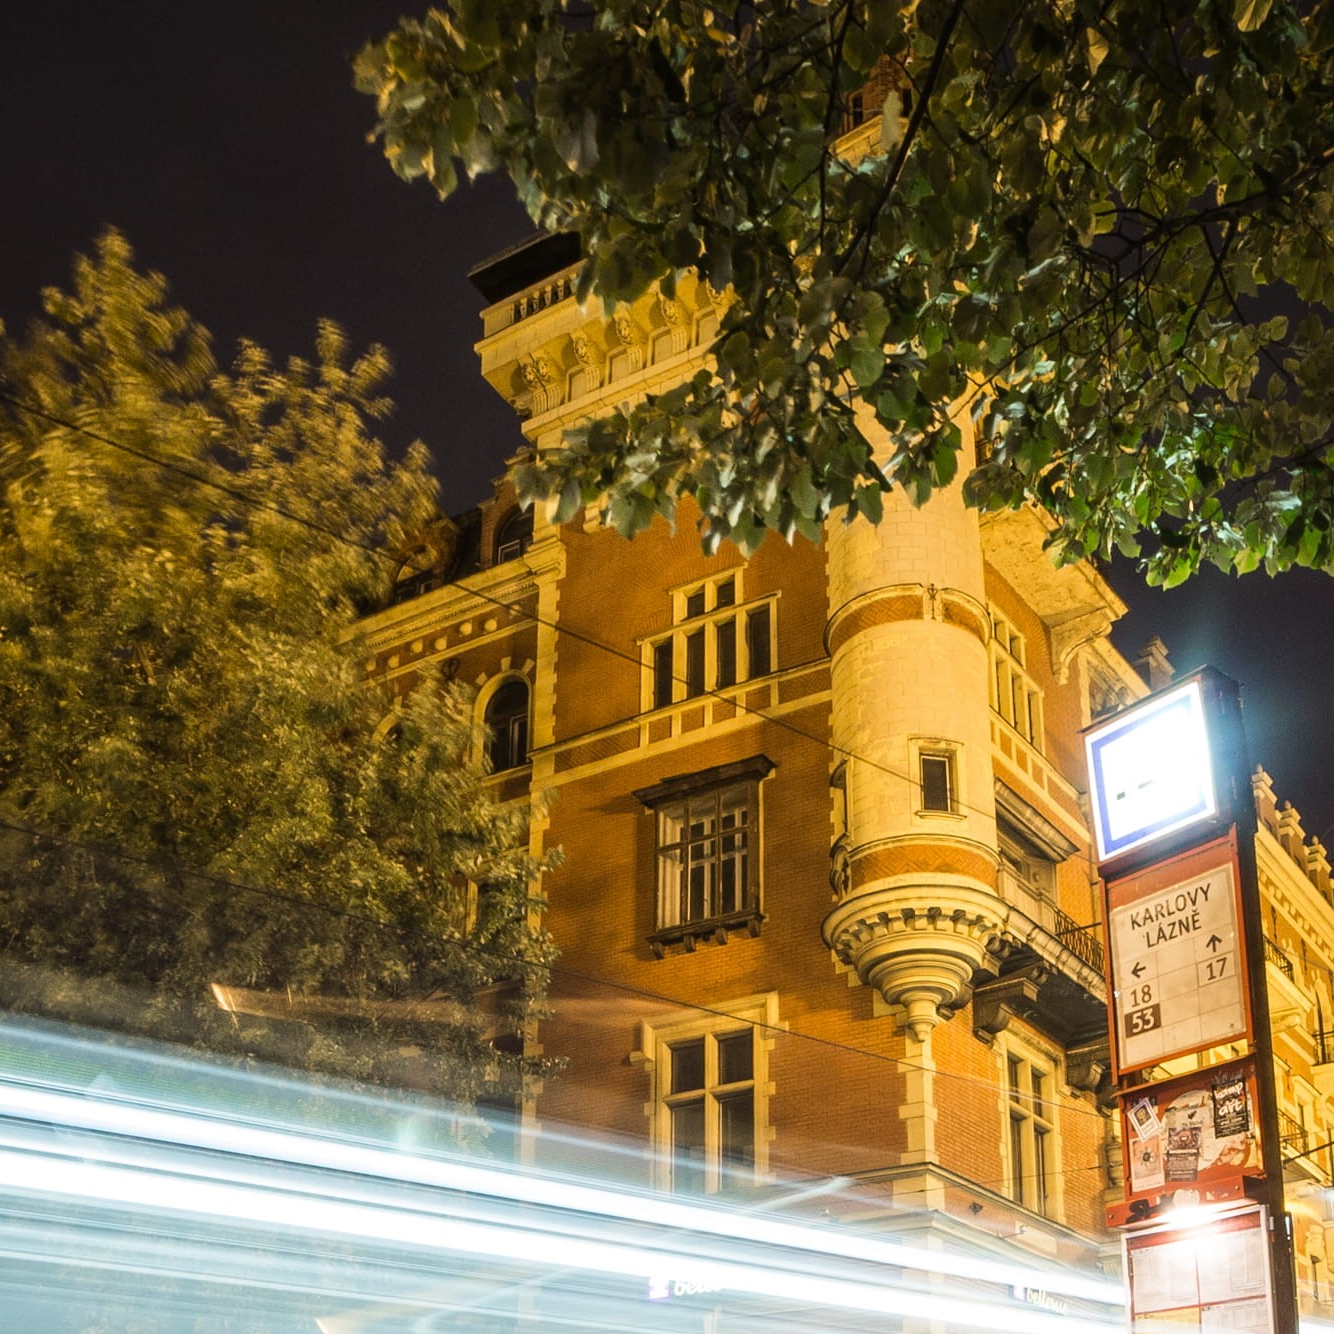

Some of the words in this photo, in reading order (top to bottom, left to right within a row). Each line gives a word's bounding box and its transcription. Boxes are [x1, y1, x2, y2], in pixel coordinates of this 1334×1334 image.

[1130, 883, 1211, 931] KARLOVY
[1146, 907, 1202, 948] LÁZNĚ
[1206, 957, 1227, 981] 17
[1130, 984, 1152, 1008] 18
[1132, 1008, 1155, 1033] 53
[1218, 1098, 1243, 1116] art
